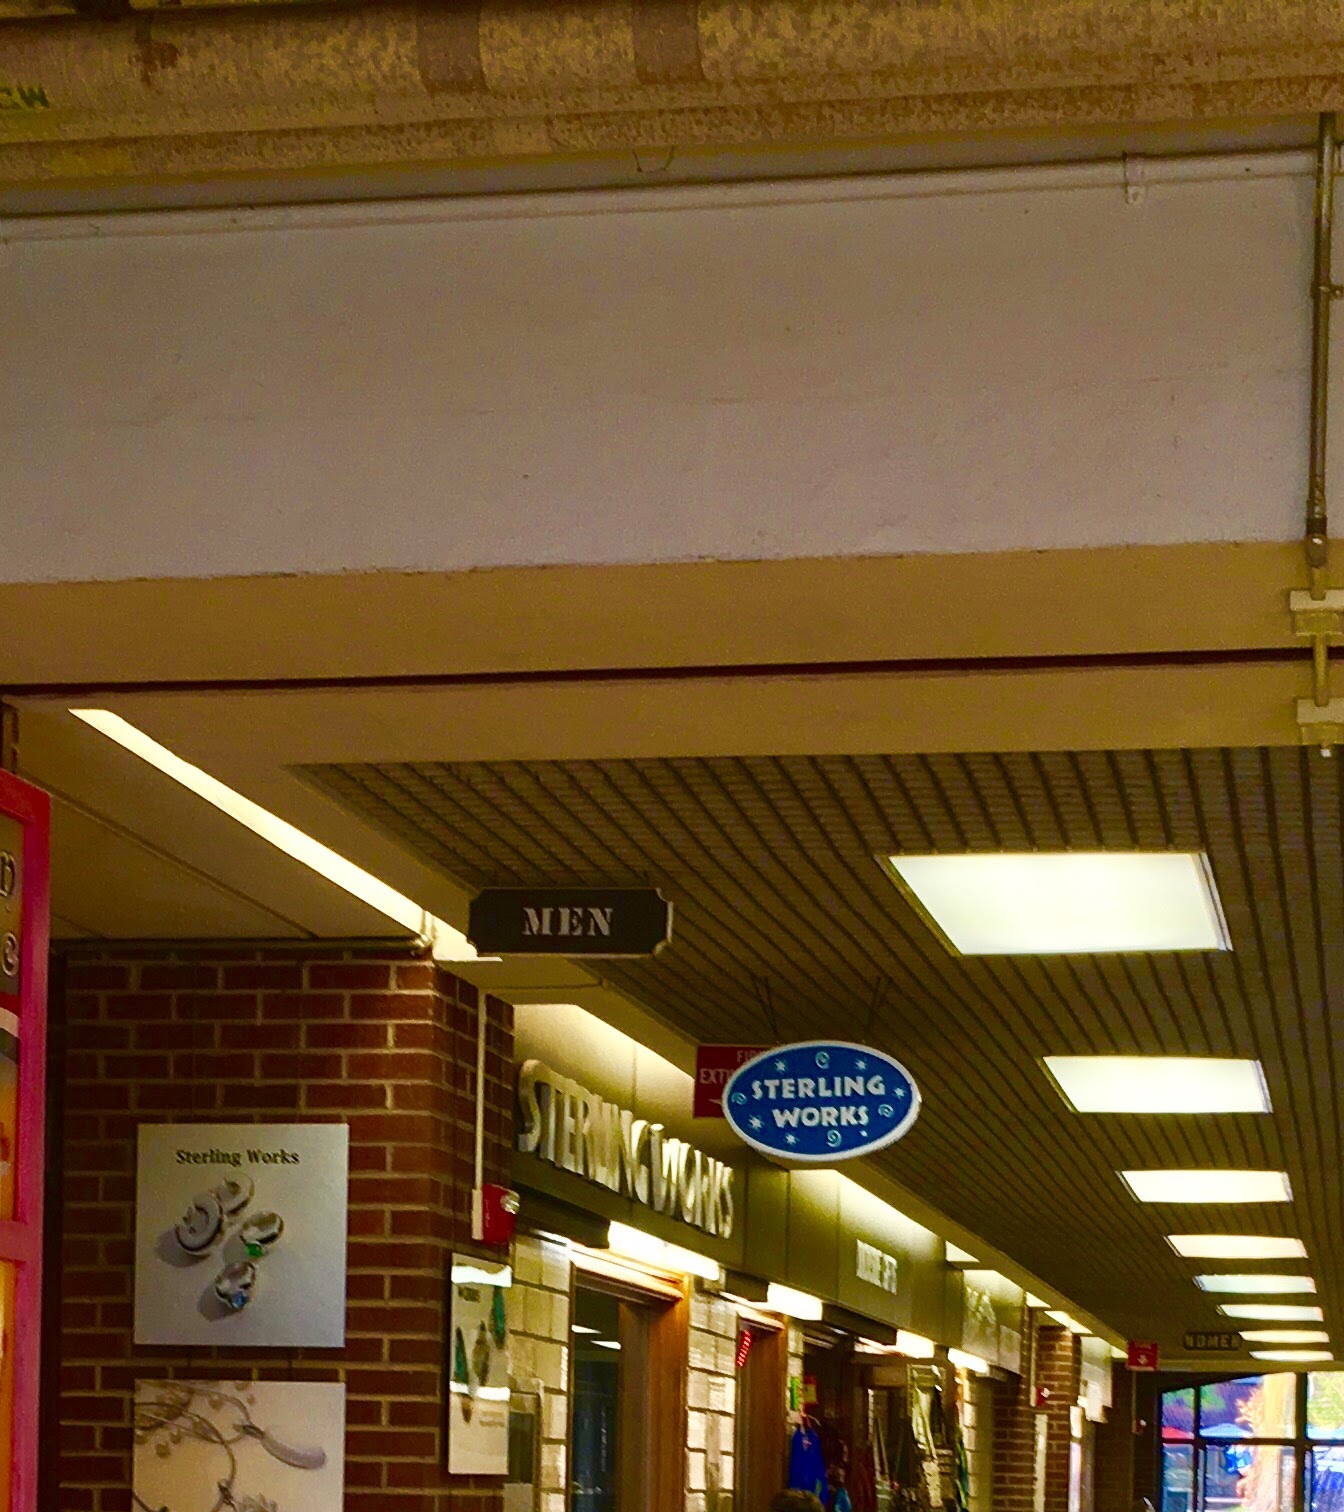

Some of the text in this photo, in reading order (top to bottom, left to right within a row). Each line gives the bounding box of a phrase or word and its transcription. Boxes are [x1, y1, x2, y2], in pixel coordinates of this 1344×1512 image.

[522, 906, 614, 937] MEN
[751, 1074, 886, 1101] STERLING
[771, 1104, 870, 1128] WORKS
[176, 1148, 299, 1167] Sterling Works
